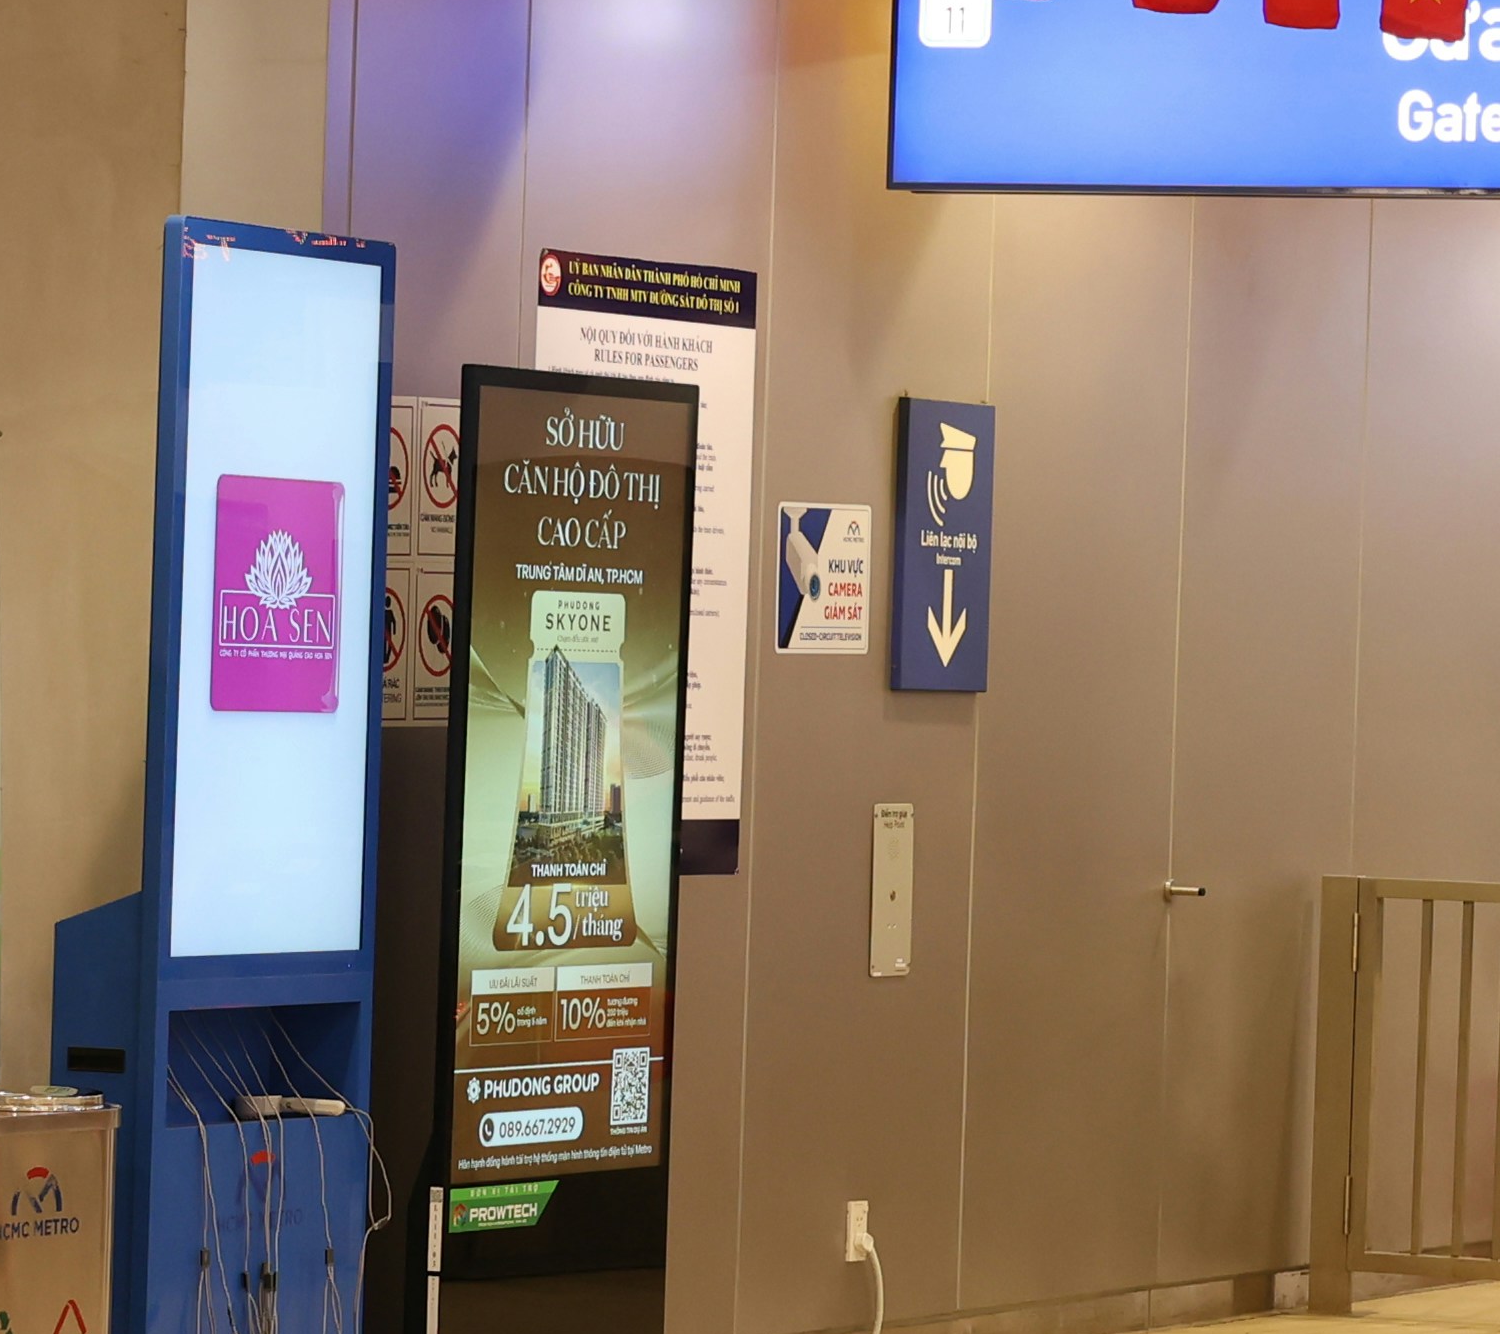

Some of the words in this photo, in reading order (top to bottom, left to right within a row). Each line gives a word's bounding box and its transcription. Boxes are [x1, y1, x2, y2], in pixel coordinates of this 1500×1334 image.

[946, 7, 965, 34] 11
[594, 348, 623, 363] RULES
[625, 351, 643, 366] FOR
[645, 353, 699, 371] PASSENGERS
[546, 407, 574, 447] SỞ
[578, 415, 625, 451] HỮU
[503, 459, 548, 495] CĂN
[553, 462, 585, 505] HỘ
[589, 464, 620, 500] ĐÔ
[624, 472, 660, 510] THỊ
[537, 516, 581, 547] CAO
[585, 509, 626, 549] CẤP
[921, 529, 939, 547] Liên
[940, 531, 952, 551] lạc
[953, 533, 966, 552] nội
[967, 533, 977, 553] bộ
[515, 563, 551, 580] TRUNG
[553, 563, 575, 581] TÂM
[576, 563, 587, 582] DĨ
[588, 568, 604, 584] AN,
[606, 569, 643, 584] TP.HCM
[828, 559, 846, 573] KHU
[847, 558, 863, 578] VỰC
[828, 582, 863, 597] CAMERA
[558, 600, 600, 610] PHUDONG
[824, 602, 846, 620] GIÁM
[847, 601, 862, 620] SÁT
[222, 605, 277, 641] HOA
[288, 608, 332, 643] SEN
[545, 613, 611, 631] SKYONE
[531, 864, 564, 877] THANH
[565, 861, 589, 877] TOÁN
[590, 859, 606, 876] CHỈ
[506, 882, 572, 946] 4.5
[575, 889, 609, 912] triệu
[476, 1001, 515, 1035] 5%
[560, 997, 606, 1031] 10%
[483, 1075, 550, 1099] PHUDONG
[553, 1072, 600, 1094] GROUP
[499, 1117, 576, 1138] 089.667.2929
[469, 1203, 538, 1222] PROWTECH
[33, 1217, 80, 1237] METRO
